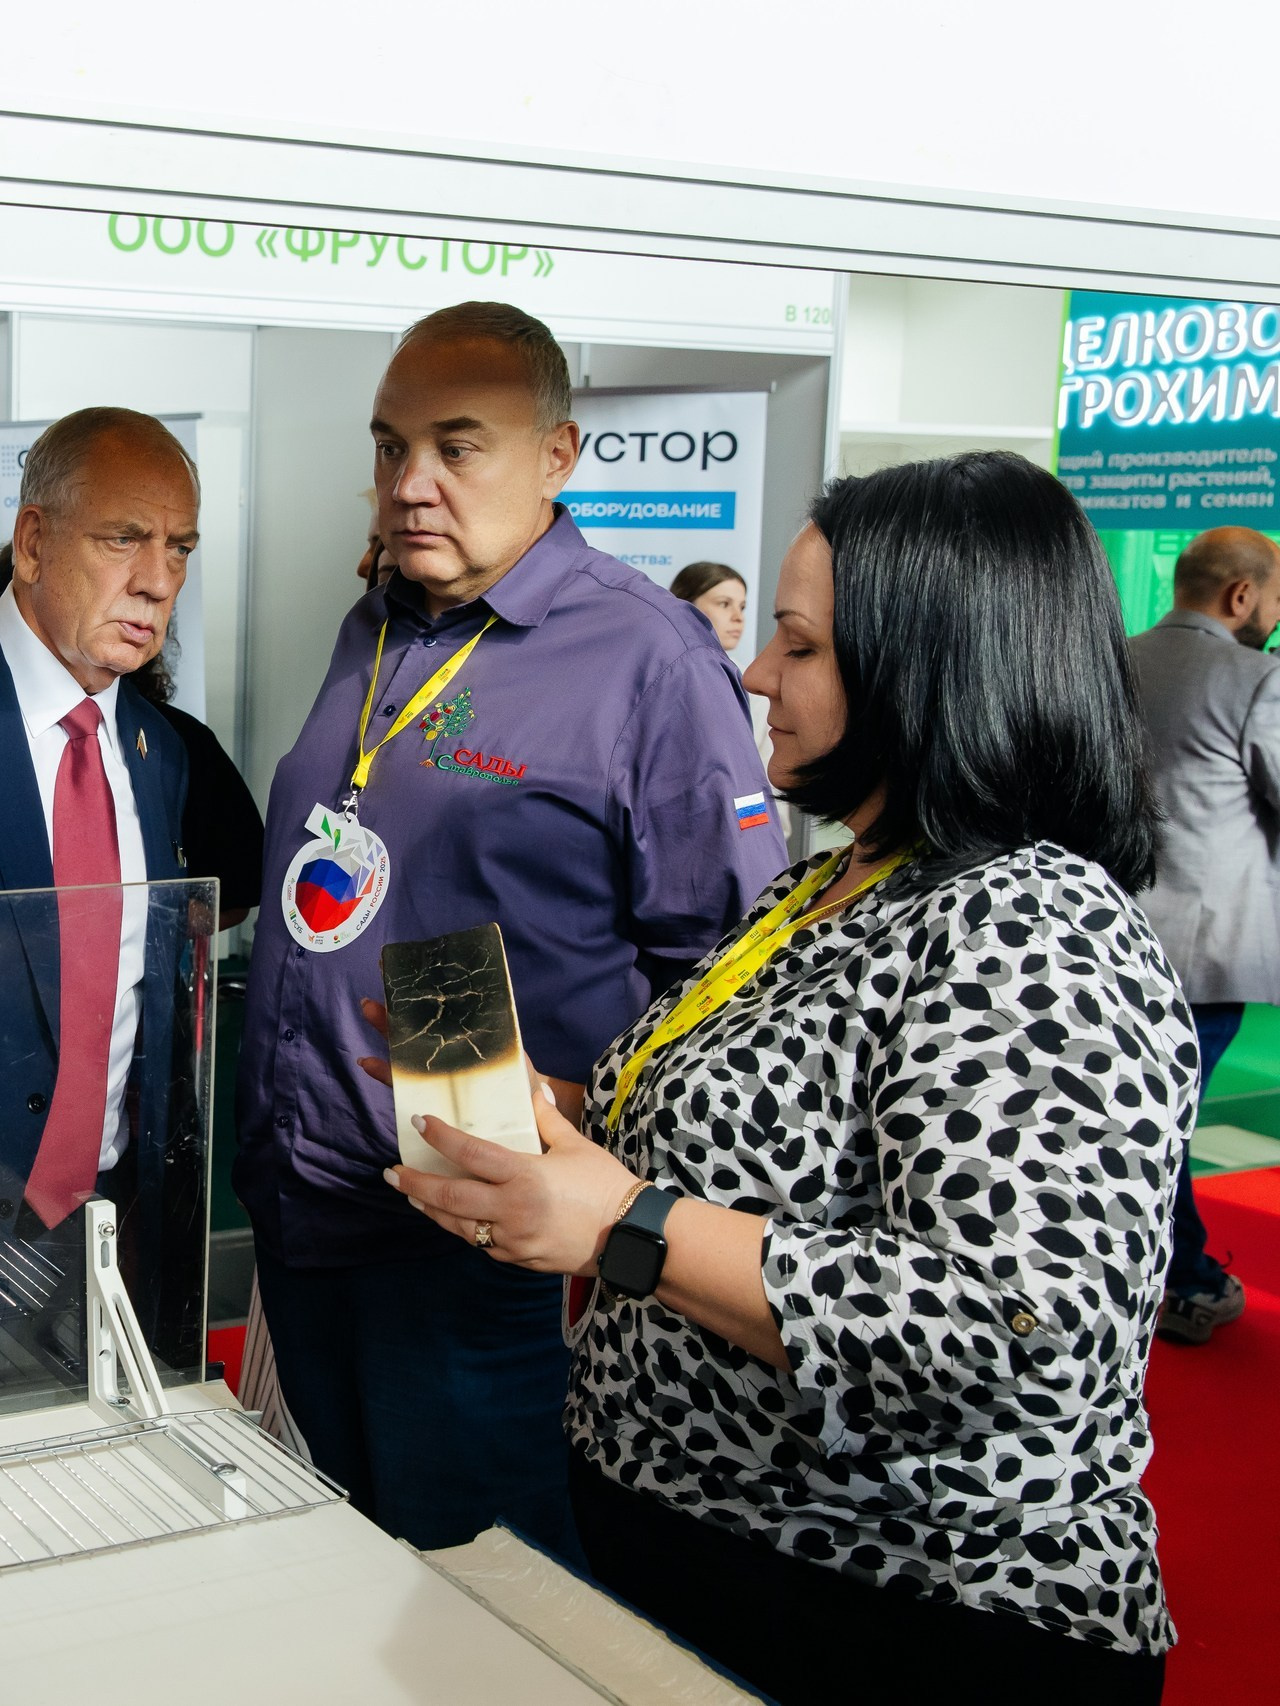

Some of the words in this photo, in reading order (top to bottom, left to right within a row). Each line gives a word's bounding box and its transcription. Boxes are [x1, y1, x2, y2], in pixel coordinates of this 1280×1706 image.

[108, 212, 235, 257] ООО
[803, 305, 831, 325] 120
[1107, 447, 1278, 472] производитель
[1089, 473, 1166, 491] защиты
[570, 501, 723, 520] ОБОРУДОВАНИЕ
[1175, 493, 1192, 509] и
[1200, 491, 1275, 509] семян
[617, 553, 673, 567] ества:
[435, 753, 521, 787] Ставрополья
[454, 747, 528, 779] САДЫ
[356, 909, 372, 932] САДЫ
[370, 876, 385, 908] РОССИИ
